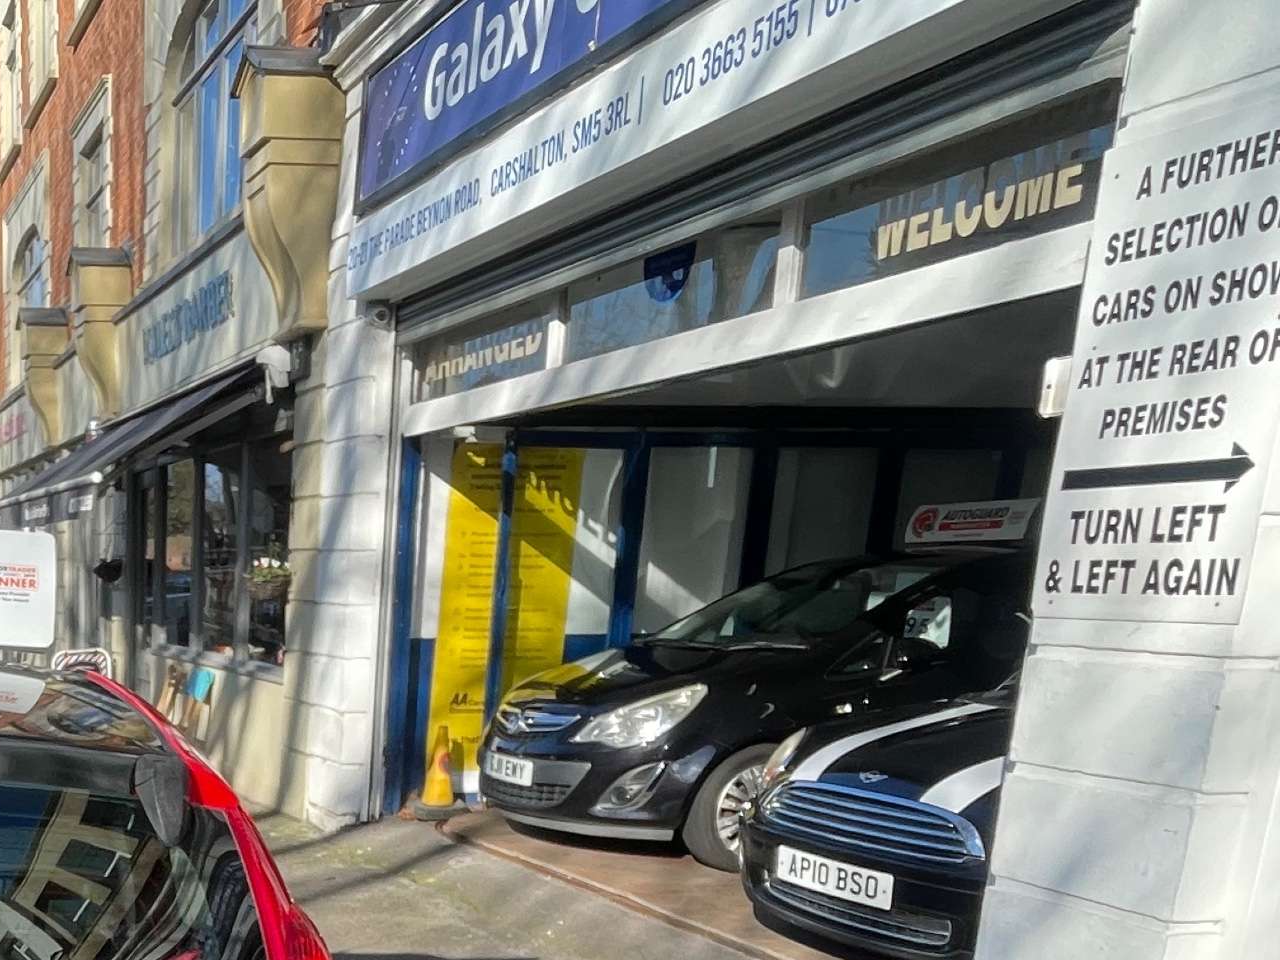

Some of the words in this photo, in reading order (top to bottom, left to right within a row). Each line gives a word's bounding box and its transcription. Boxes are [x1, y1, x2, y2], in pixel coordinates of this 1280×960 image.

[423, 0, 555, 121] Galaxy
[384, 212, 417, 252] PARADE
[416, 193, 452, 237] BEYNON
[490, 131, 568, 197] CARSHALTON,
[572, 108, 601, 153] SM5
[604, 91, 631, 136] 3RL
[663, 56, 695, 106] 020
[699, 27, 747, 87] 3663
[751, 0, 799, 59] 5155
[1136, 165, 1153, 201] A
[1105, 202, 1249, 266] SELECTION
[1258, 195, 1280, 232] O
[1092, 284, 1155, 327] CARS
[1165, 276, 1203, 315] ON
[1078, 355, 1108, 390] AT
[1117, 346, 1162, 381] THE
[1169, 334, 1240, 375] REAR
[1099, 394, 1228, 440] PREMISES
[1070, 508, 1143, 545] TURN
[1150, 504, 1226, 543] LEFT
[1045, 559, 1061, 594] &
[1071, 560, 1136, 595] LEFT
[1142, 558, 1240, 596] AGAIN
[788, 854, 830, 886] AP10
[835, 867, 879, 899] BSO
